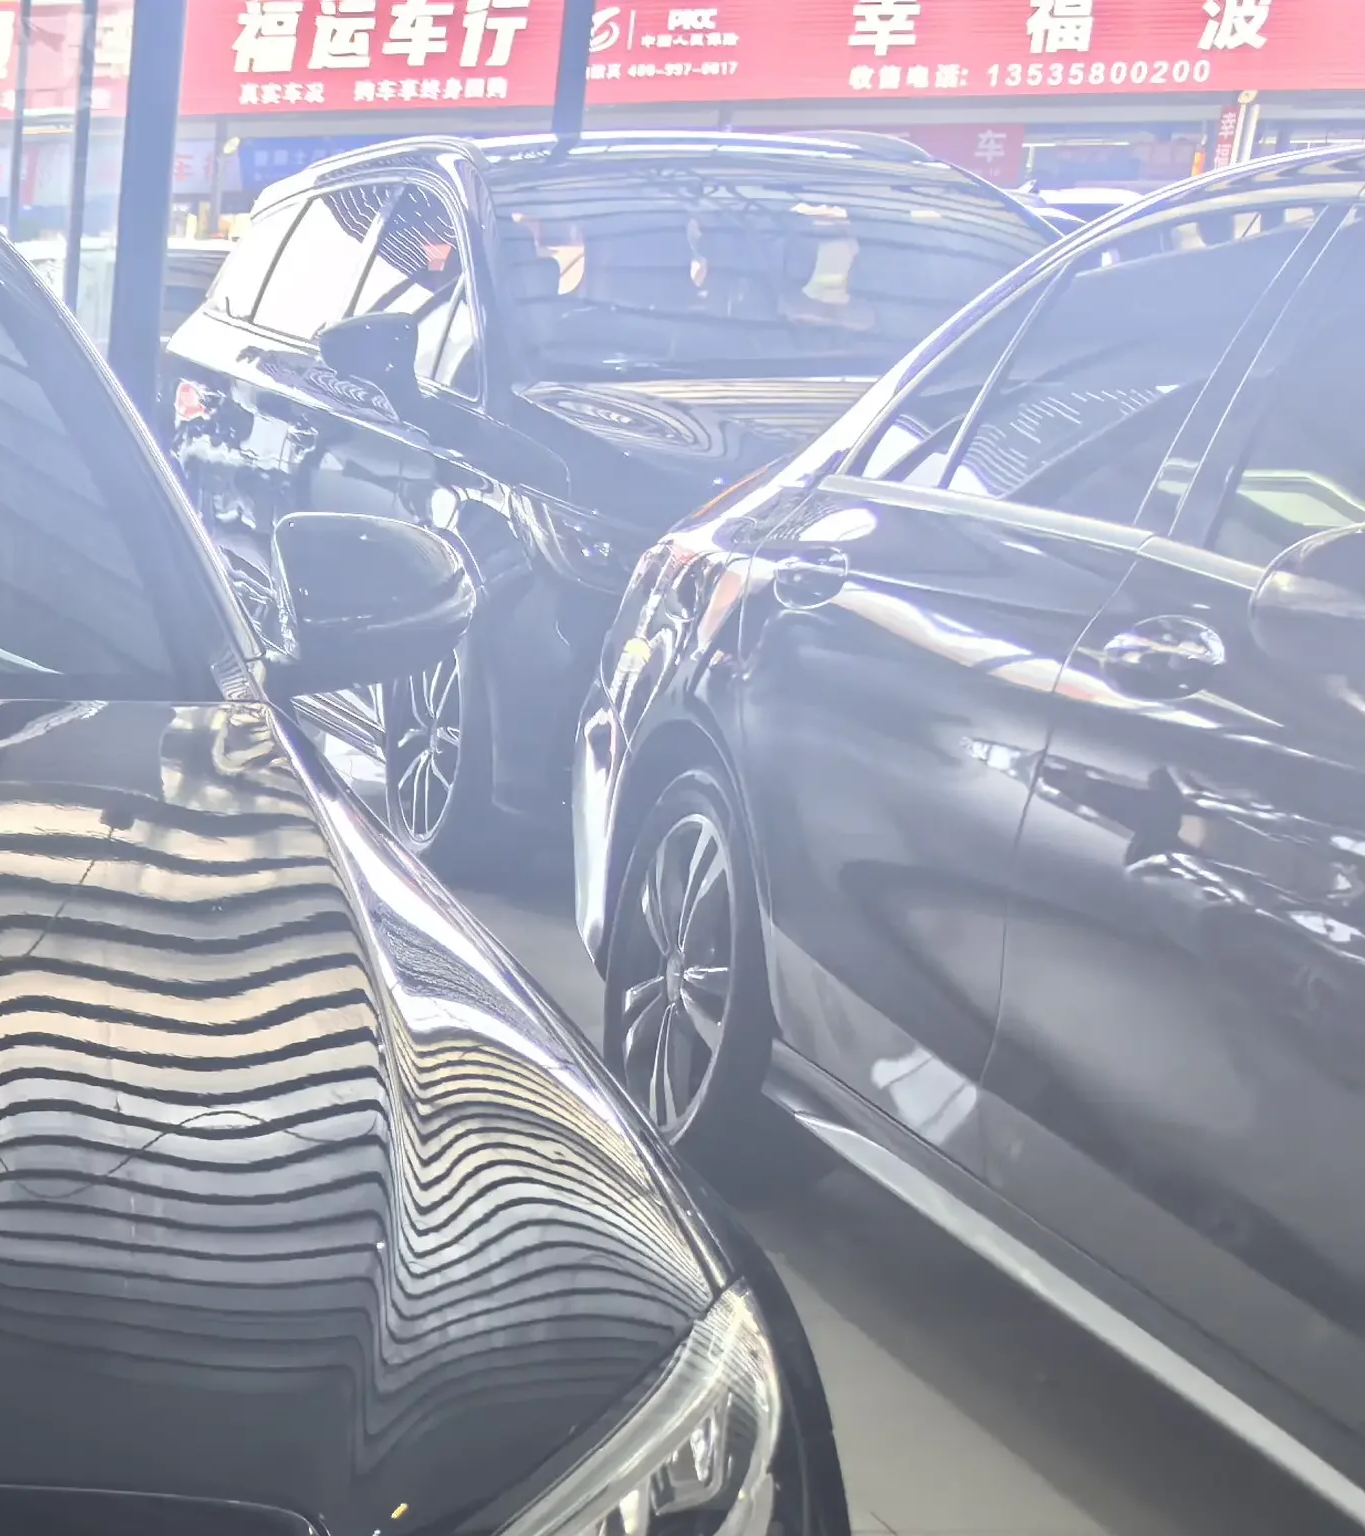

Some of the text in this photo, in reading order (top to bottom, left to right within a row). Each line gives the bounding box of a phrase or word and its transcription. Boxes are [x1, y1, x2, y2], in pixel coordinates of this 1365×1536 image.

[232, 0, 530, 73] 福运车行
[986, 59, 1212, 87] 13535800200
